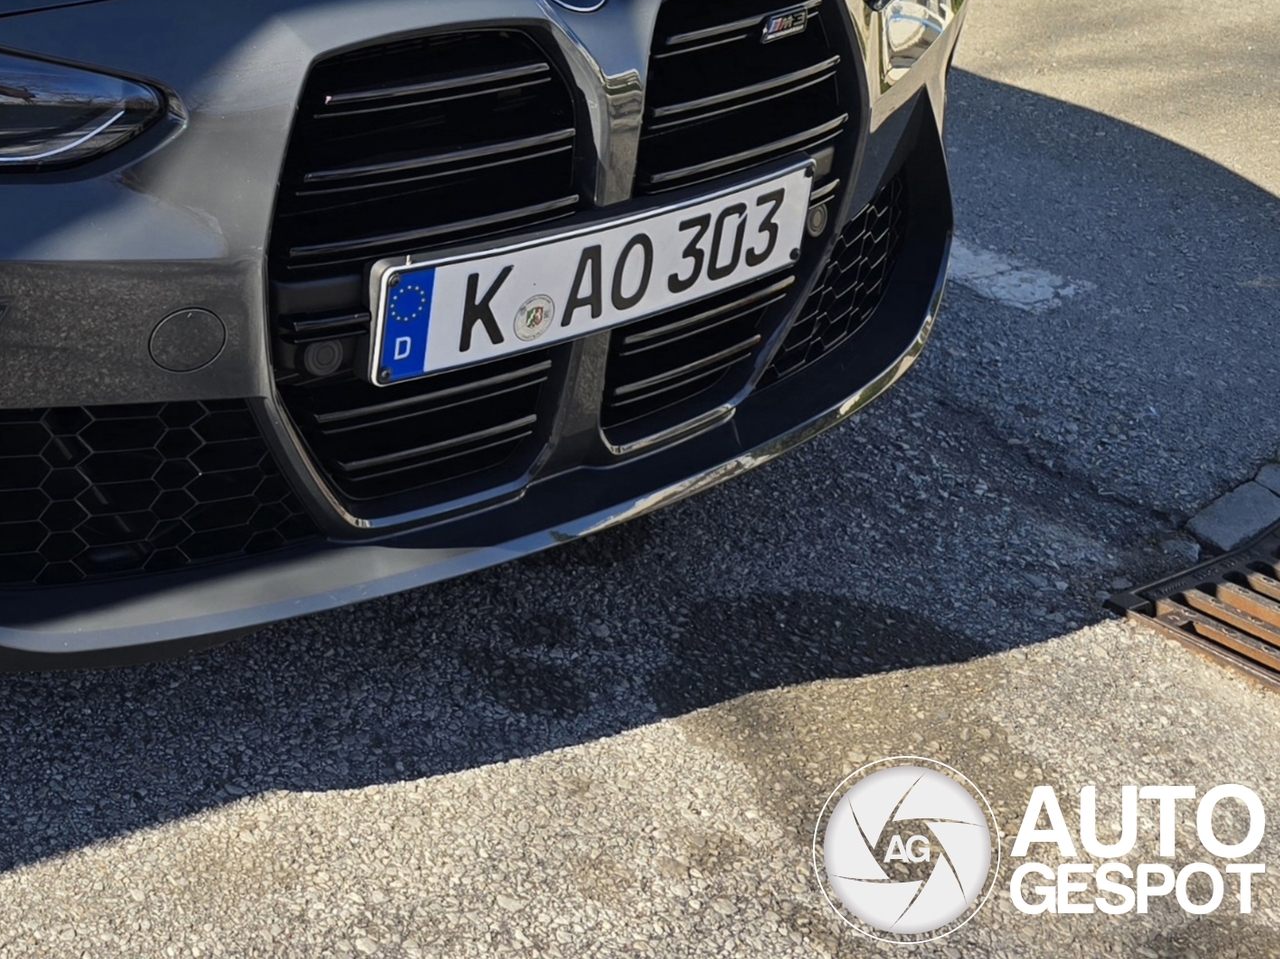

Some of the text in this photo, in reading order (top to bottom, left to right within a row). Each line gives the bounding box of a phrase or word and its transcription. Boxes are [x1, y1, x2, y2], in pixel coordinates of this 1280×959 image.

[459, 264, 514, 352] K
[561, 233, 653, 327] AO
[668, 187, 785, 294] 303
[393, 336, 412, 360] D
